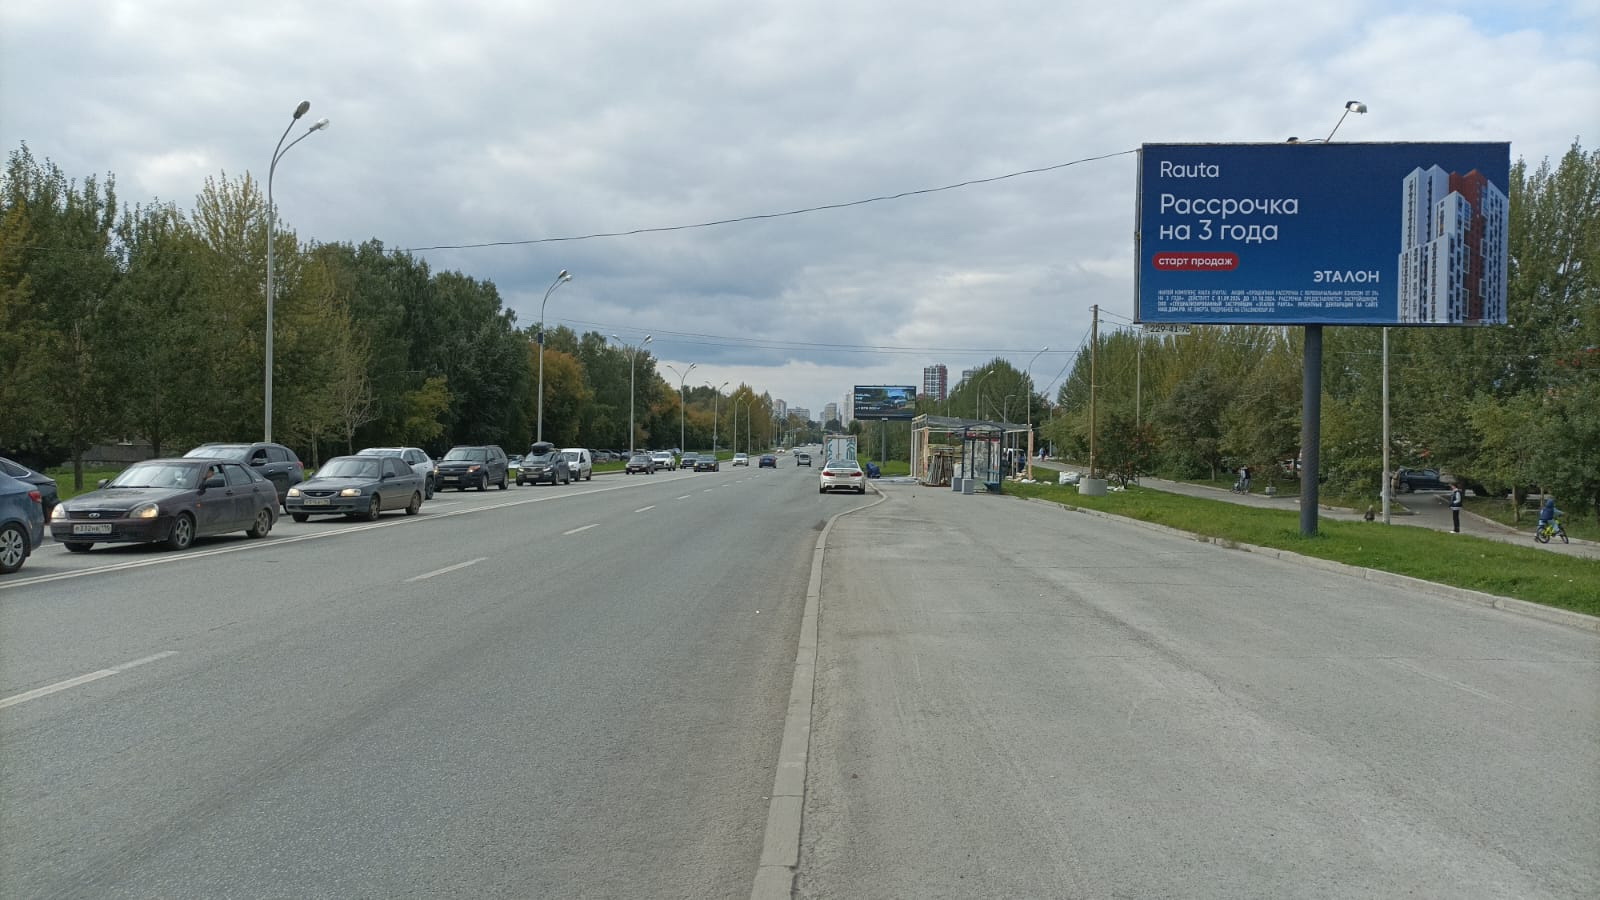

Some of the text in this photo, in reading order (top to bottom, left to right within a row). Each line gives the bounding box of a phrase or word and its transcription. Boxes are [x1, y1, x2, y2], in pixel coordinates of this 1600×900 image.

[1160, 161, 1220, 178] Rauta
[1160, 193, 1299, 219] Рассрочка
[1159, 219, 1279, 244] на 3 года
[1158, 257, 1233, 267] старт продаж
[1312, 270, 1380, 283] ЭТАЛОН
